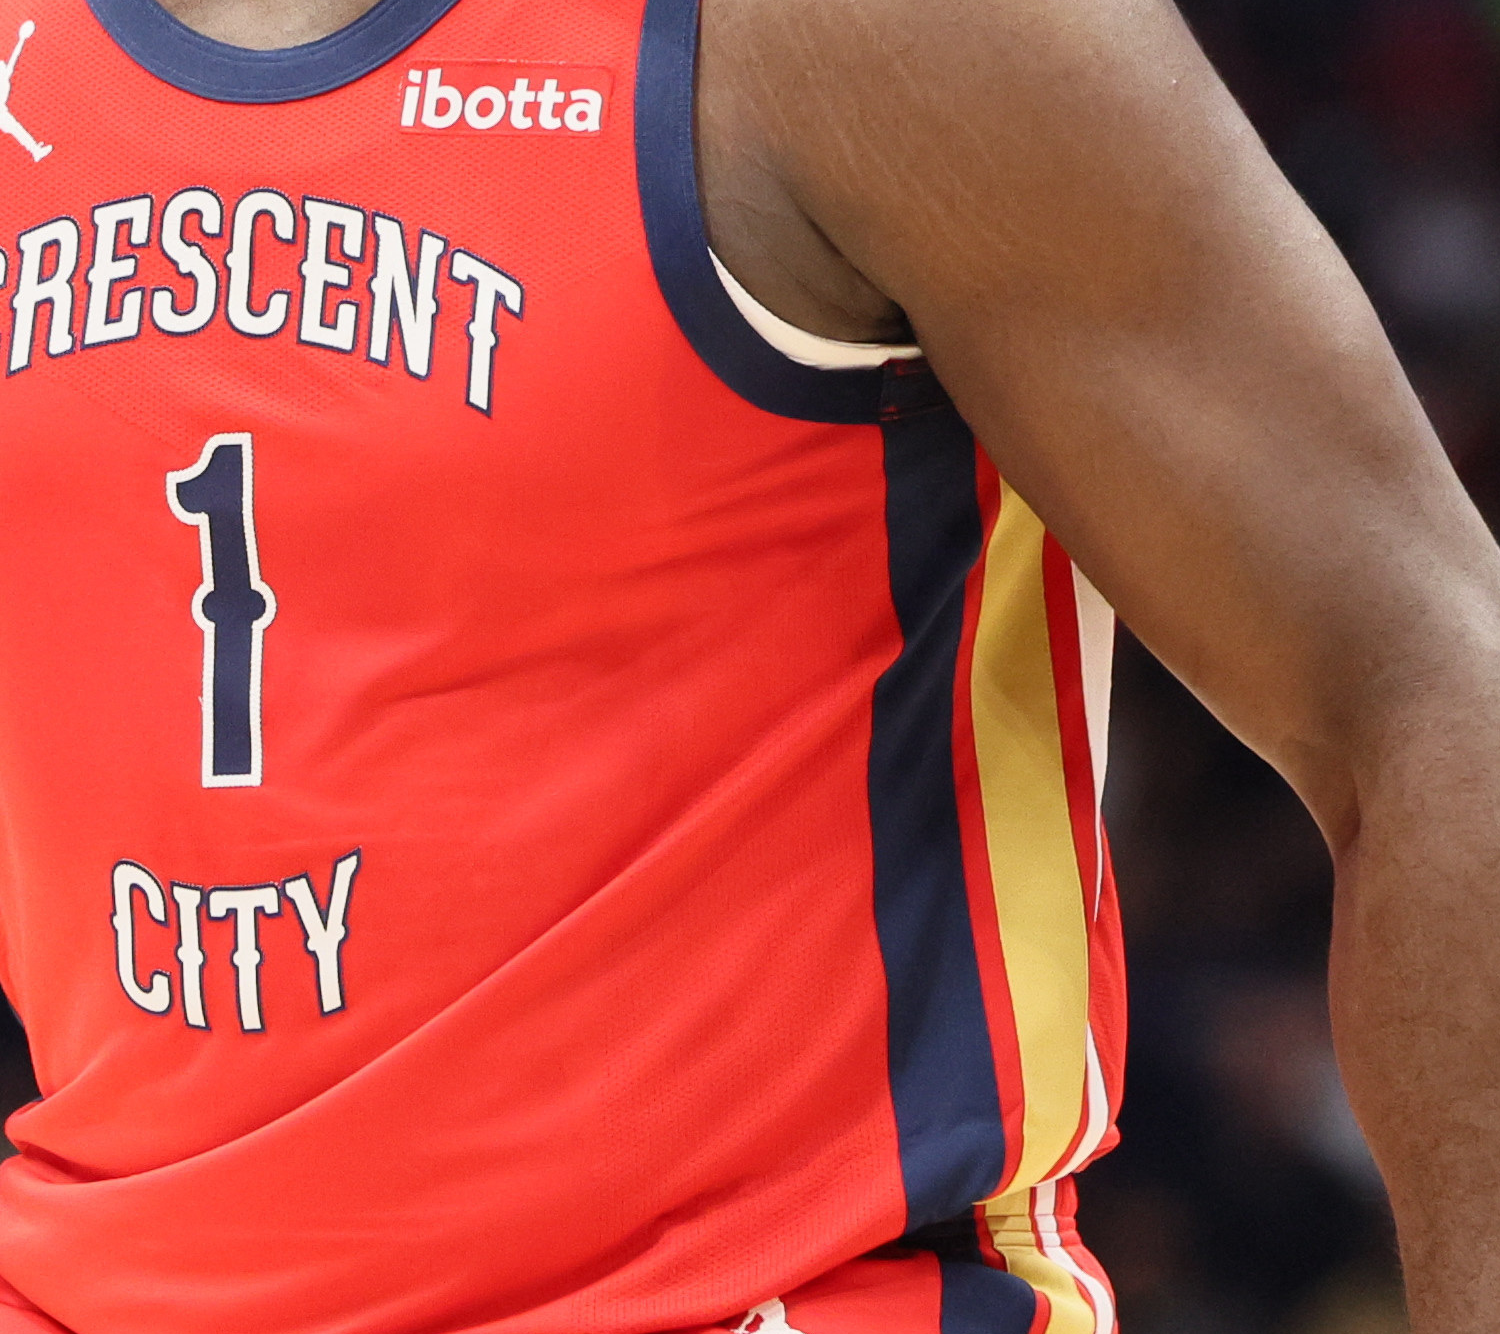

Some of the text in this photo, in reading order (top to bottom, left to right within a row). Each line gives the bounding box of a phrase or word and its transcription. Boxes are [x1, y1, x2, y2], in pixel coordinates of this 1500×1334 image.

[400, 67, 604, 133] ibotta
[165, 432, 277, 789] 1
[111, 846, 362, 1034] CITY
